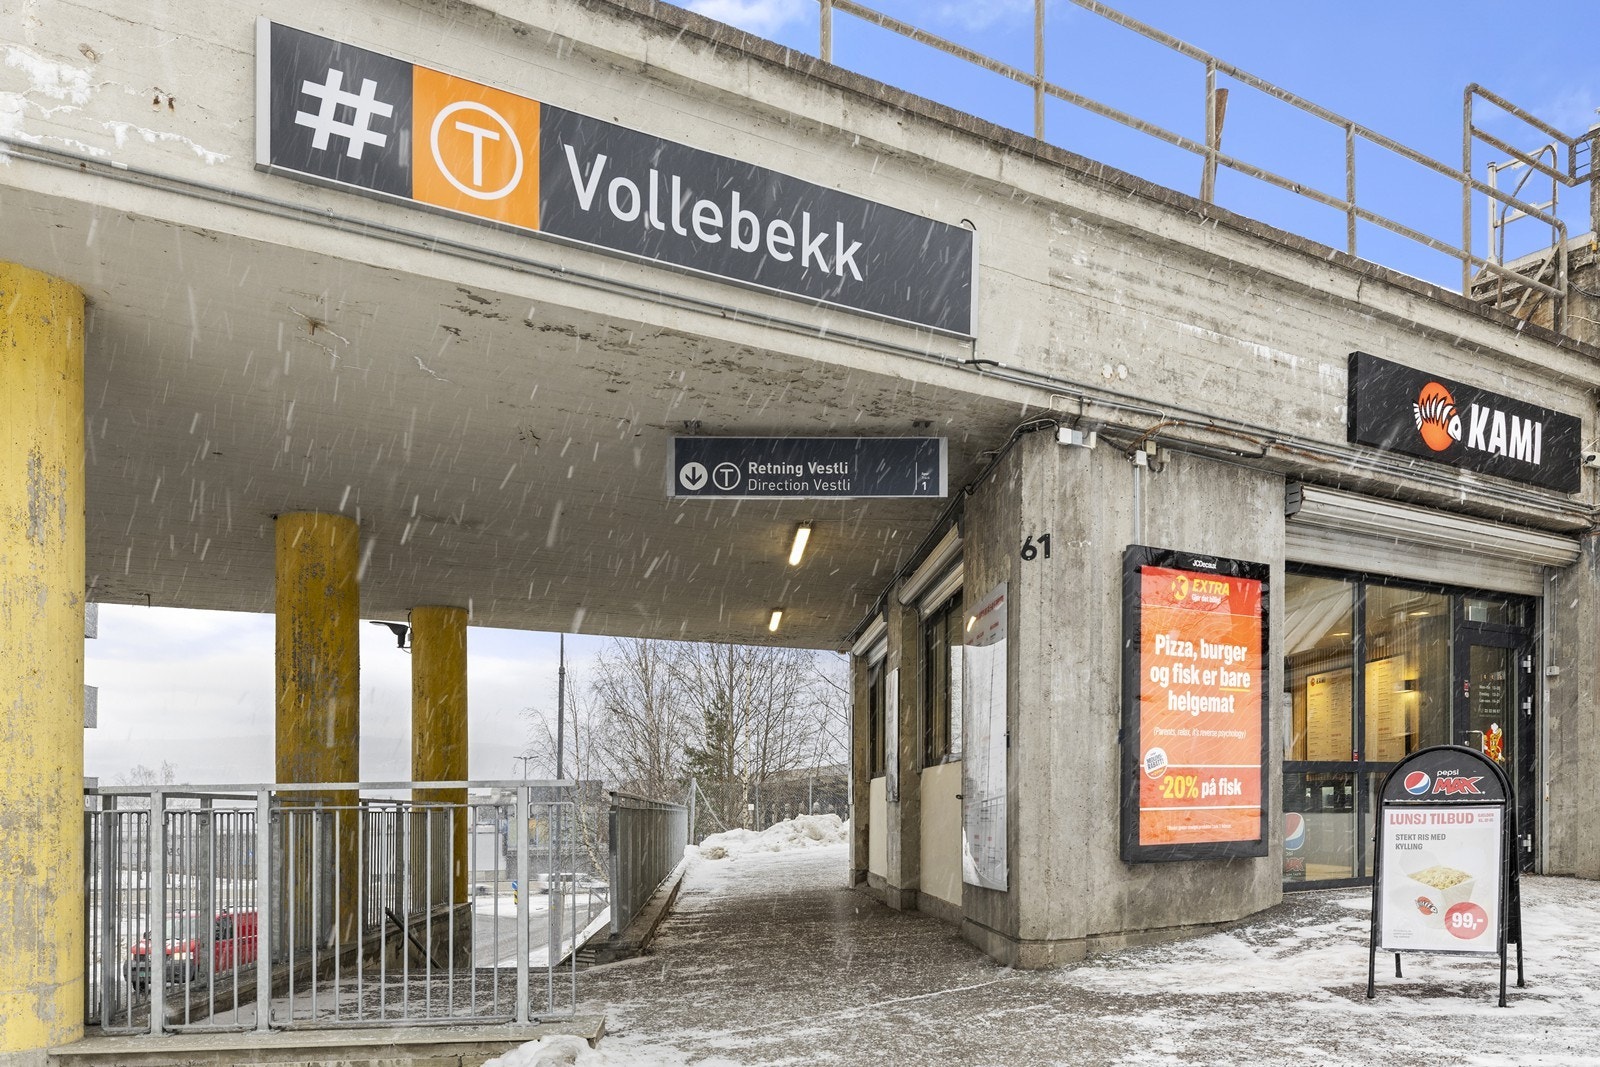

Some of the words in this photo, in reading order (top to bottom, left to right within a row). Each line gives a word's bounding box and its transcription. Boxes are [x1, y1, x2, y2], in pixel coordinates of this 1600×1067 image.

[564, 144, 865, 283] Vollebekk
[1467, 403, 1542, 465] KAMI
[748, 461, 804, 477] Retning
[807, 461, 849, 475] Vestli
[748, 478, 809, 491] Direction
[813, 478, 851, 491] Vestli
[921, 481, 927, 491] 1
[1021, 533, 1051, 561] 61
[1192, 578, 1230, 596] EXTRA
[1155, 633, 1198, 661] Pizza,
[1200, 638, 1248, 666] burger
[1150, 666, 1170, 688] og
[1172, 662, 1200, 685] fisk
[1202, 669, 1218, 686] er
[1219, 666, 1251, 688] bare
[1168, 689, 1235, 717] helgemat
[1199, 729, 1217, 738] reverse
[1436, 769, 1460, 777] pepsi
[1159, 775, 1199, 798] -20%
[1201, 778, 1217, 798] på
[1218, 777, 1242, 795] fisk
[1432, 776, 1485, 796] MAX
[1389, 813, 1427, 825] LUNSJ
[1429, 812, 1475, 825] TILBUD
[1395, 833, 1417, 841] STEKT
[1417, 833, 1430, 841] RIS
[1430, 833, 1447, 841] MED
[1395, 843, 1423, 851] KYLLING
[1451, 911, 1484, 930] 99,-
